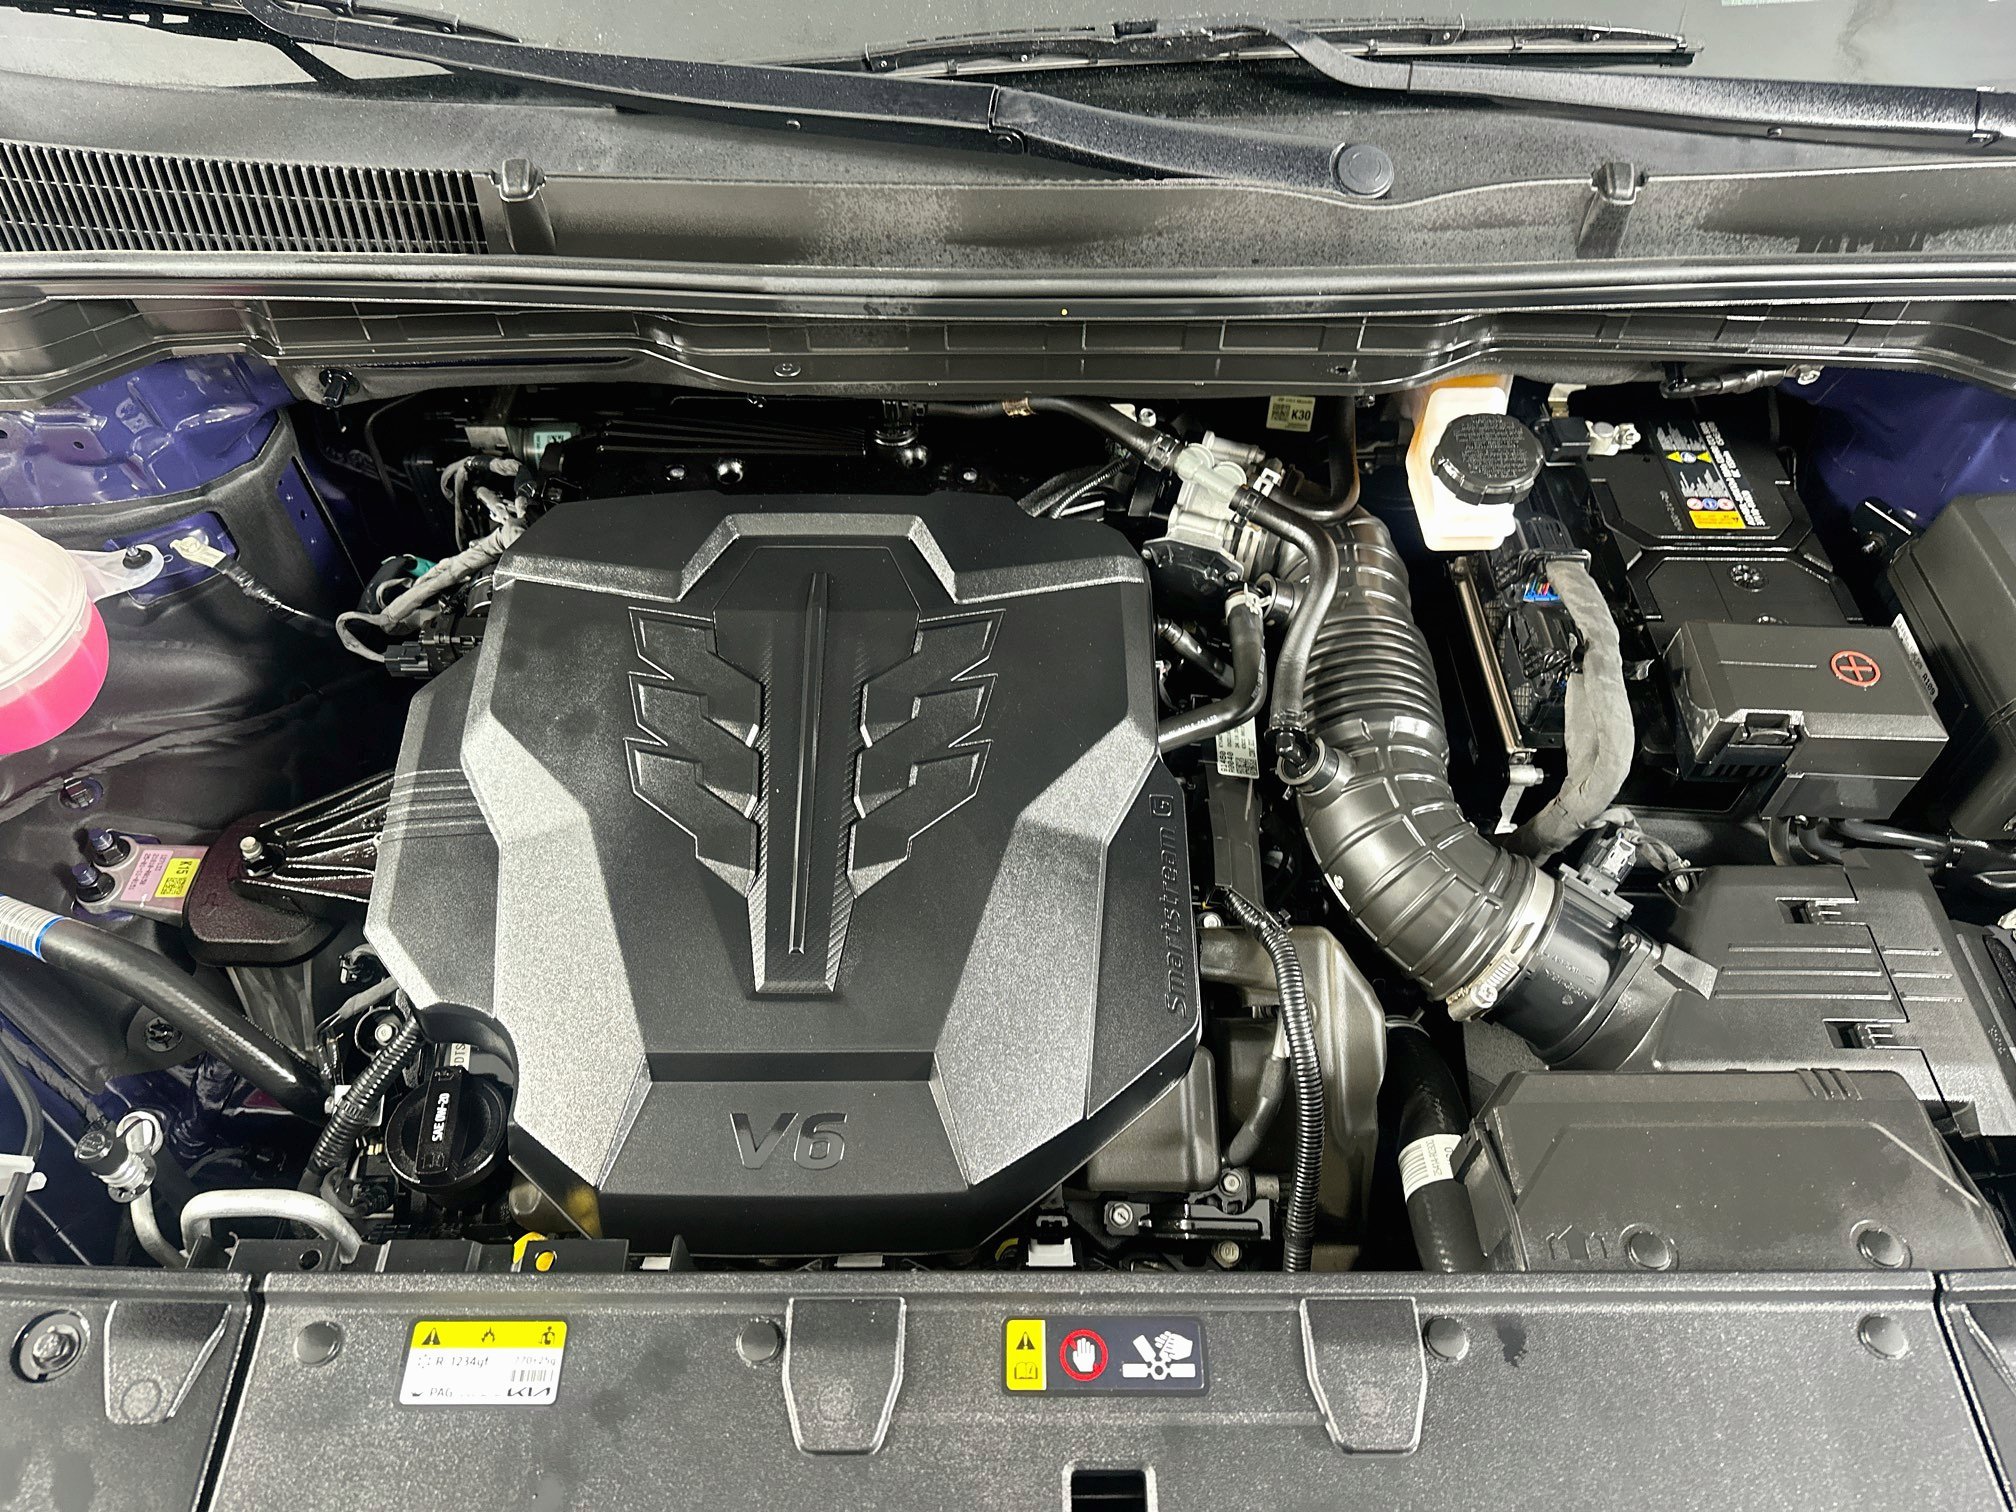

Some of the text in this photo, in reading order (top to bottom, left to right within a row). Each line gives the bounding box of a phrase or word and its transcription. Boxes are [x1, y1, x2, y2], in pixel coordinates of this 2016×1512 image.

[1291, 409, 1311, 421] K30
[176, 861, 192, 875] K15
[1149, 794, 1187, 1019] Smartstream G
[432, 1122, 445, 1142] SAE
[730, 1112, 848, 1170] V6
[507, 1387, 551, 1397] KIA
